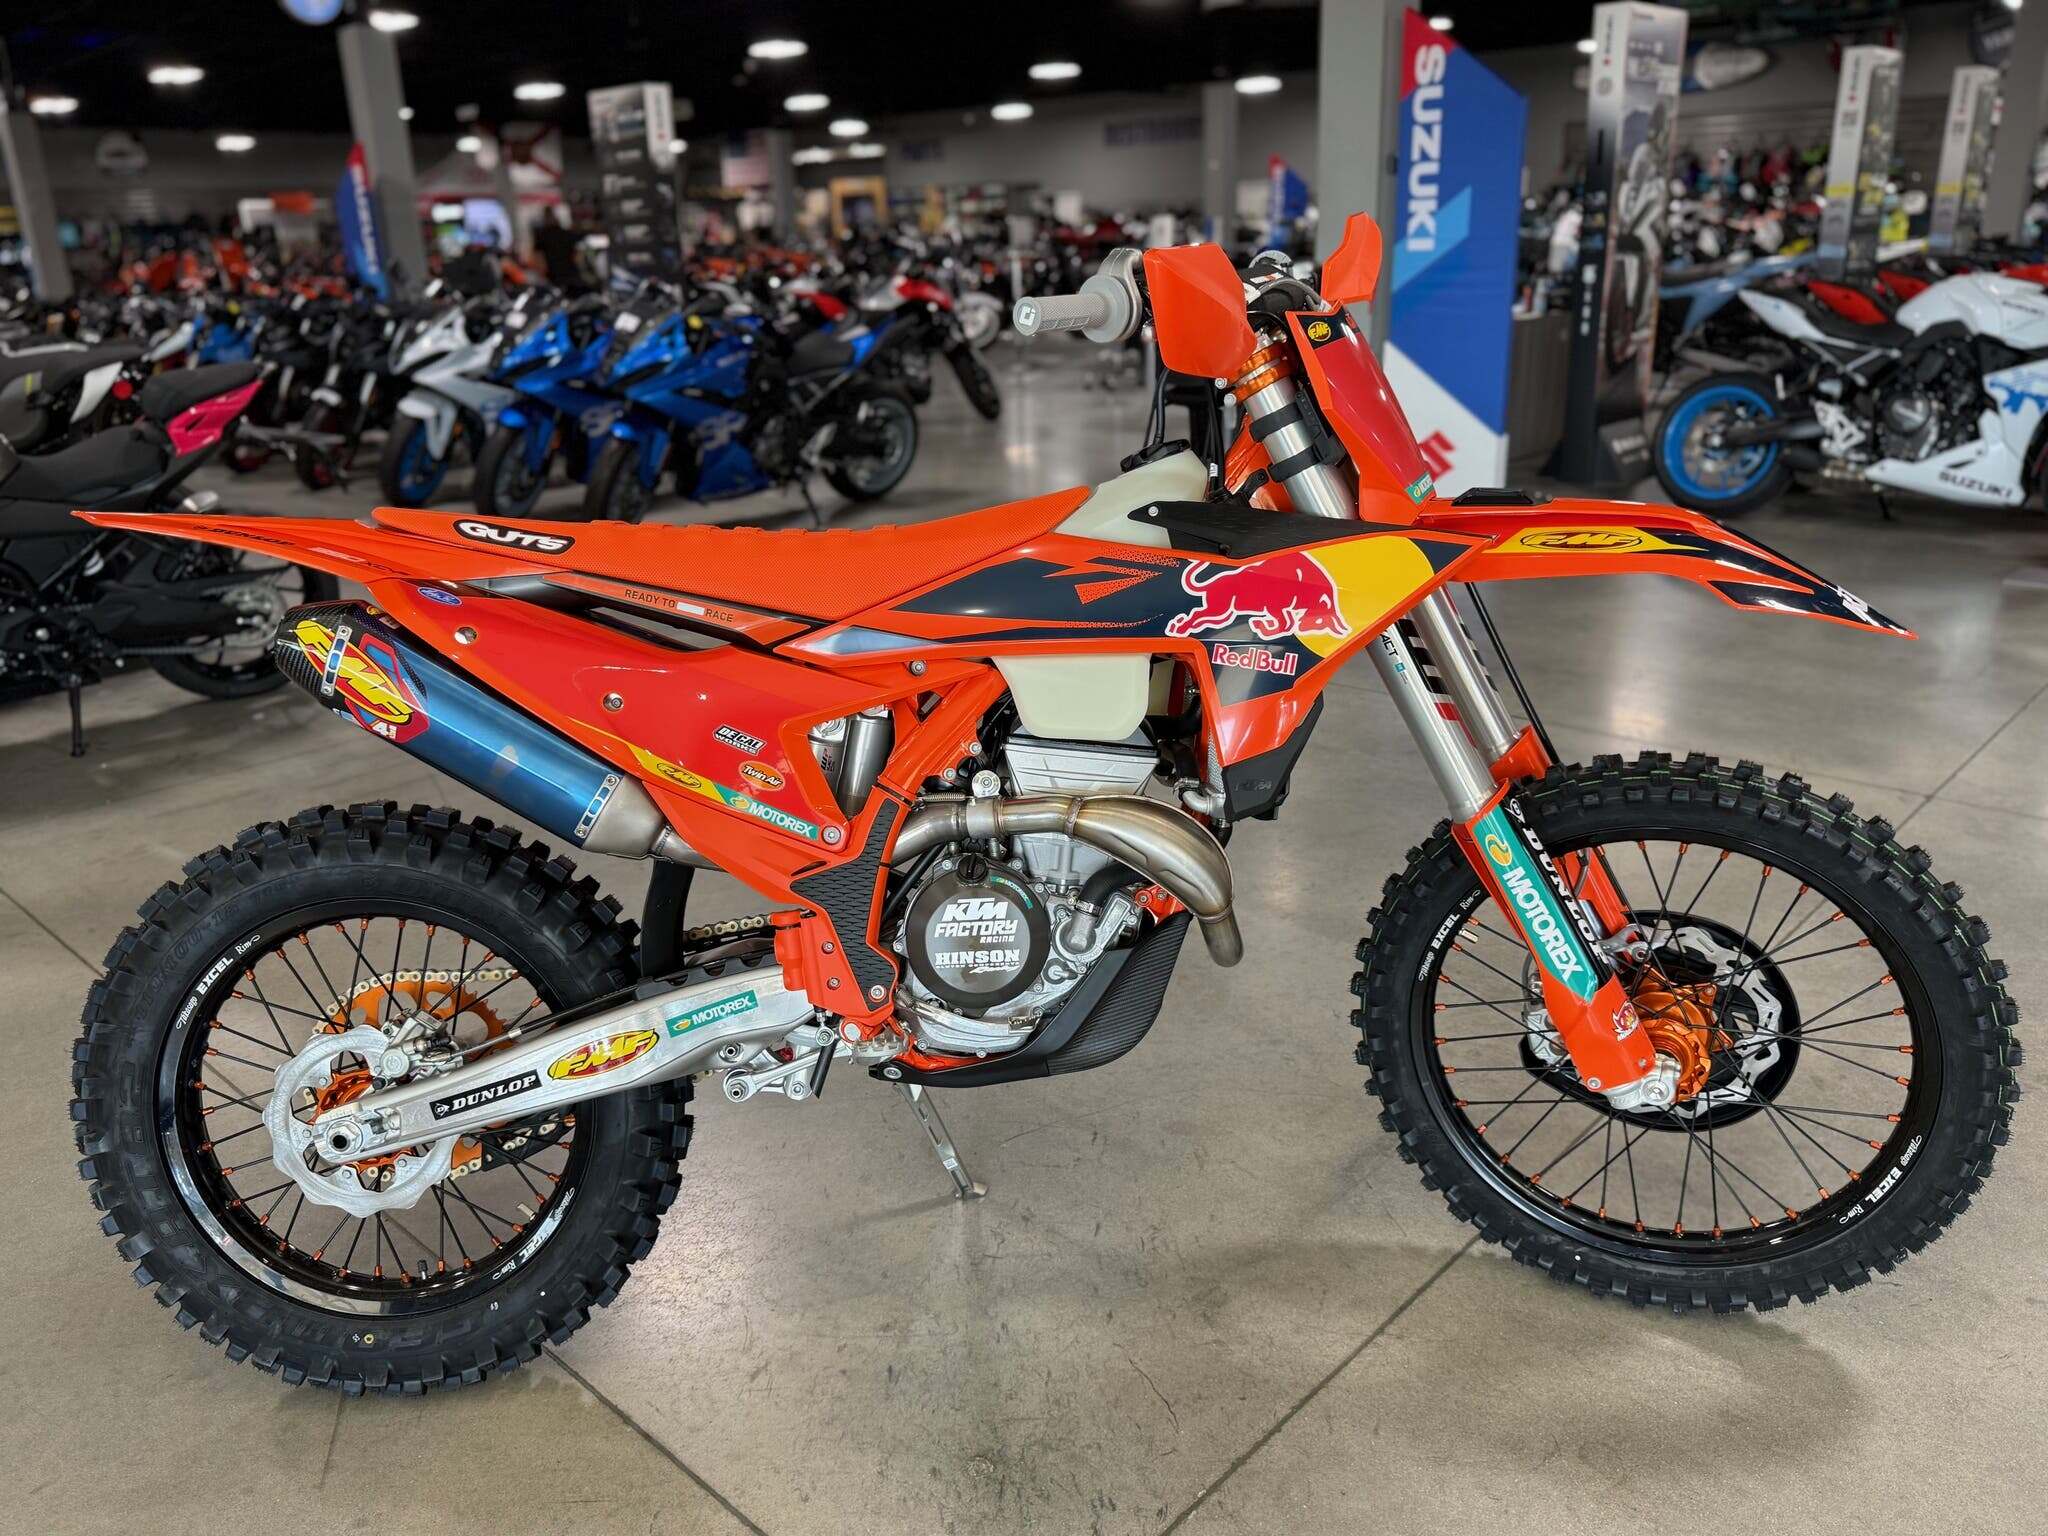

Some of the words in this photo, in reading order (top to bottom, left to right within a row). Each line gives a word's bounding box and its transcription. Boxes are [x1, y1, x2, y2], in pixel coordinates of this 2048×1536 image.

[1406, 44, 1447, 253] SUZUKI
[1939, 471, 2013, 499] SUZUKI
[459, 522, 568, 550] GUTS
[1520, 531, 1642, 550] FMF
[624, 589, 659, 606] READY
[662, 597, 676, 608] TO
[705, 608, 734, 623] RACE
[1379, 629, 1399, 656] ACT
[1212, 643, 1255, 670] Red
[1254, 649, 1299, 676] Bull
[718, 727, 765, 749] DECAL
[657, 763, 701, 788] FMF
[749, 801, 814, 838] MOTOREX
[941, 897, 1009, 922] KTM
[1522, 827, 1610, 965] DUNLOP
[934, 919, 1018, 938] FACTORY
[1431, 913, 1460, 949] EXCEL
[1459, 889, 1481, 910] Rim
[1503, 866, 1585, 982] MOTOREX
[979, 935, 1015, 944] RACING
[196, 957, 234, 995] EXCEL
[234, 934, 261, 955] Rim
[934, 948, 1020, 965] HINSON
[691, 995, 752, 1025] MOTOREX
[548, 1029, 660, 1080] FMF
[451, 1075, 537, 1111] DUNLOP
[1865, 1166, 1903, 1203] EXCEL
[1839, 1203, 1865, 1224] Rim
